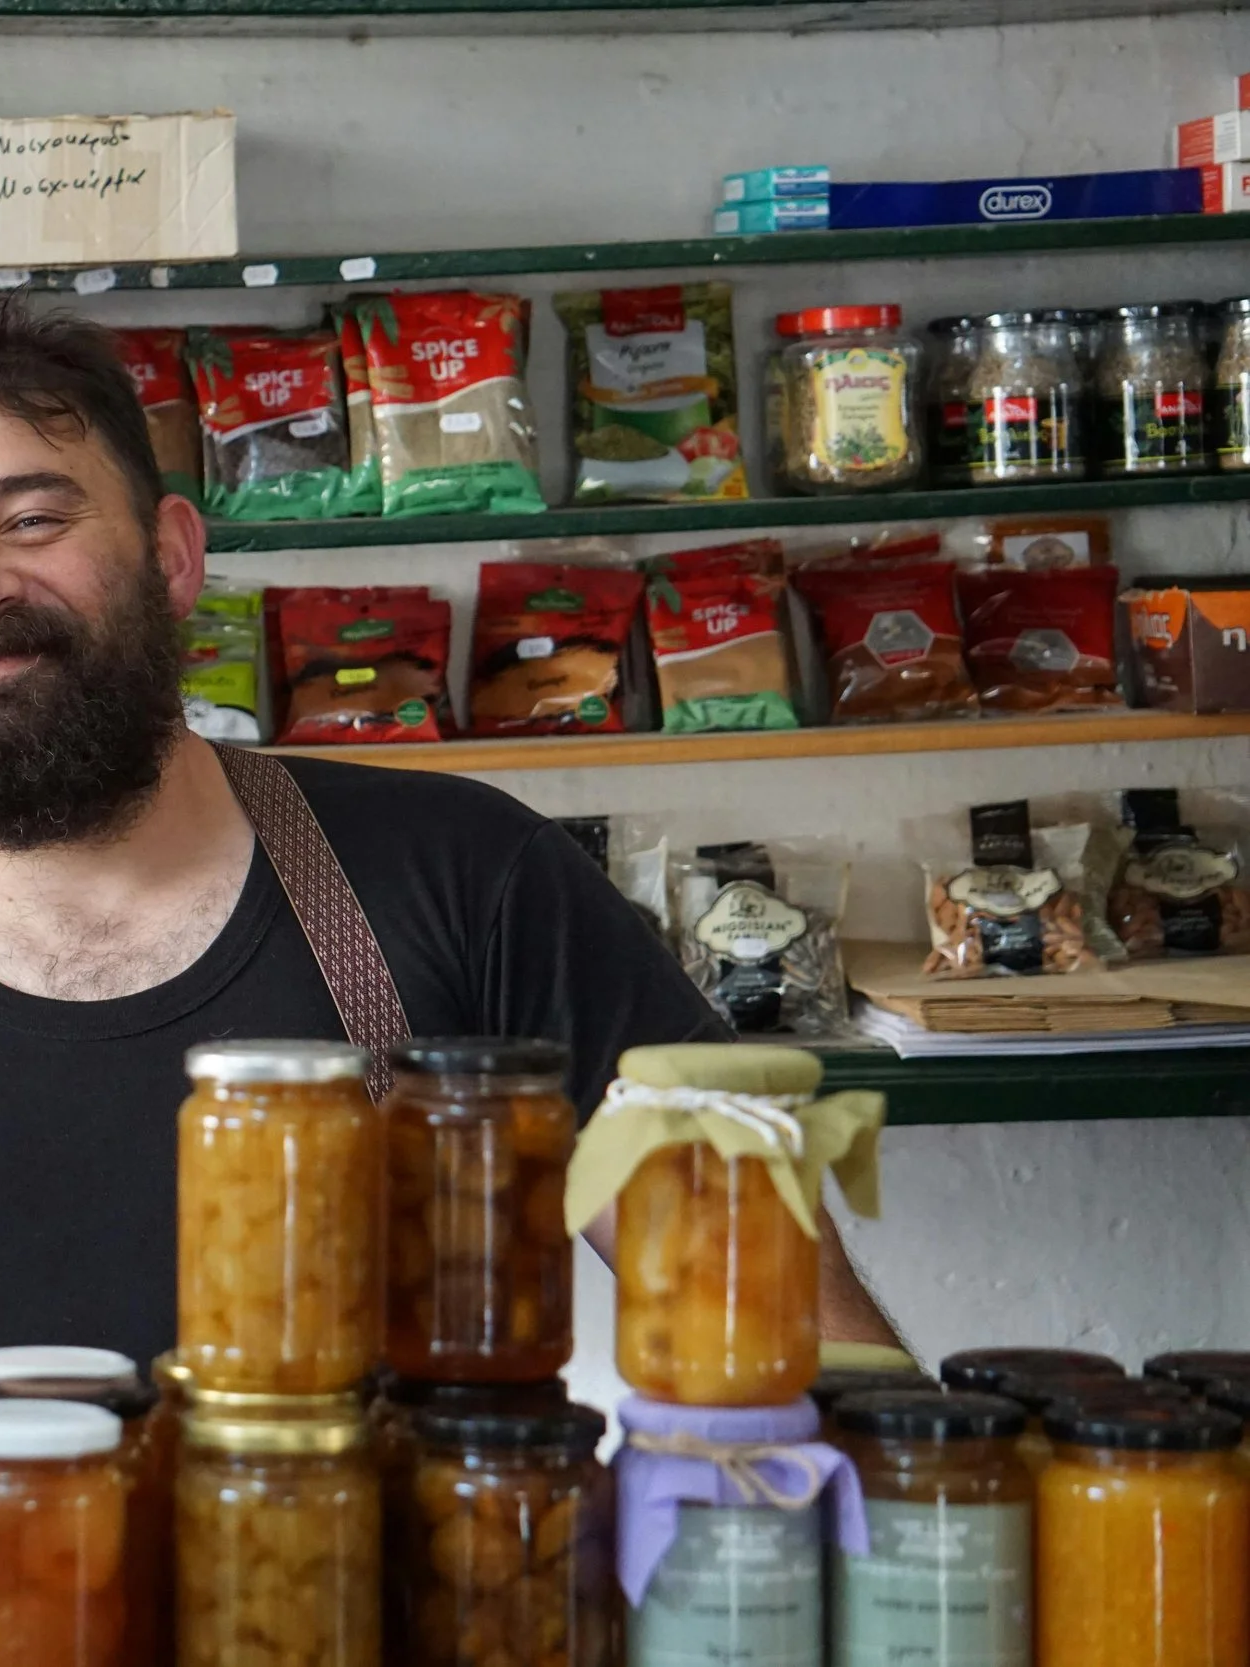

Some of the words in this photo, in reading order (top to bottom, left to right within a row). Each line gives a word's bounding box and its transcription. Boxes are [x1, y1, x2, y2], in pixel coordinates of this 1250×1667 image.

[987, 191, 1044, 213] durex
[411, 338, 479, 361] SPICE
[245, 369, 303, 391] SPICE
[429, 358, 465, 380] UP
[259, 387, 291, 407] UP
[692, 604, 750, 622] SPICE
[707, 618, 738, 635] UP
